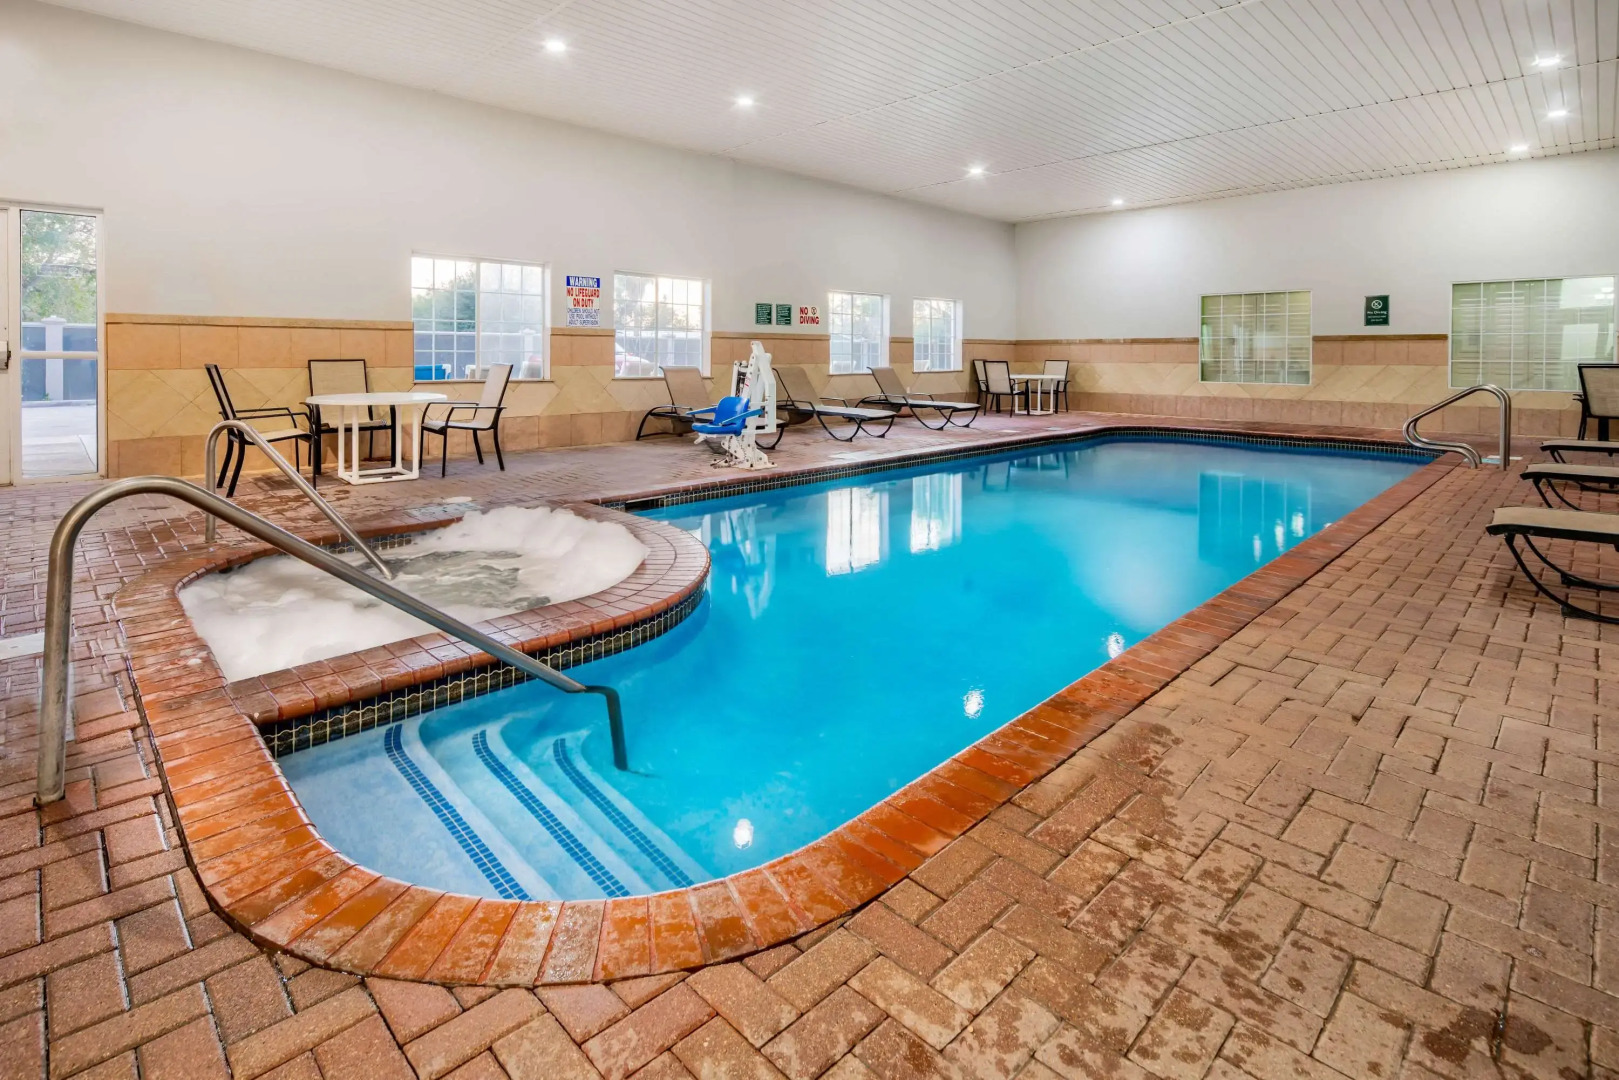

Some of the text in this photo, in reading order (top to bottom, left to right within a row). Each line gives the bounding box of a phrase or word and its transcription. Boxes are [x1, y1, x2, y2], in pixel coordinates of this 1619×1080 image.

[569, 277, 597, 288] WARNING
[566, 288, 600, 298] NO LIFEGUARD
[573, 298, 594, 308] ON DUTY
[800, 306, 808, 315] NO
[800, 316, 820, 324] DIVING
